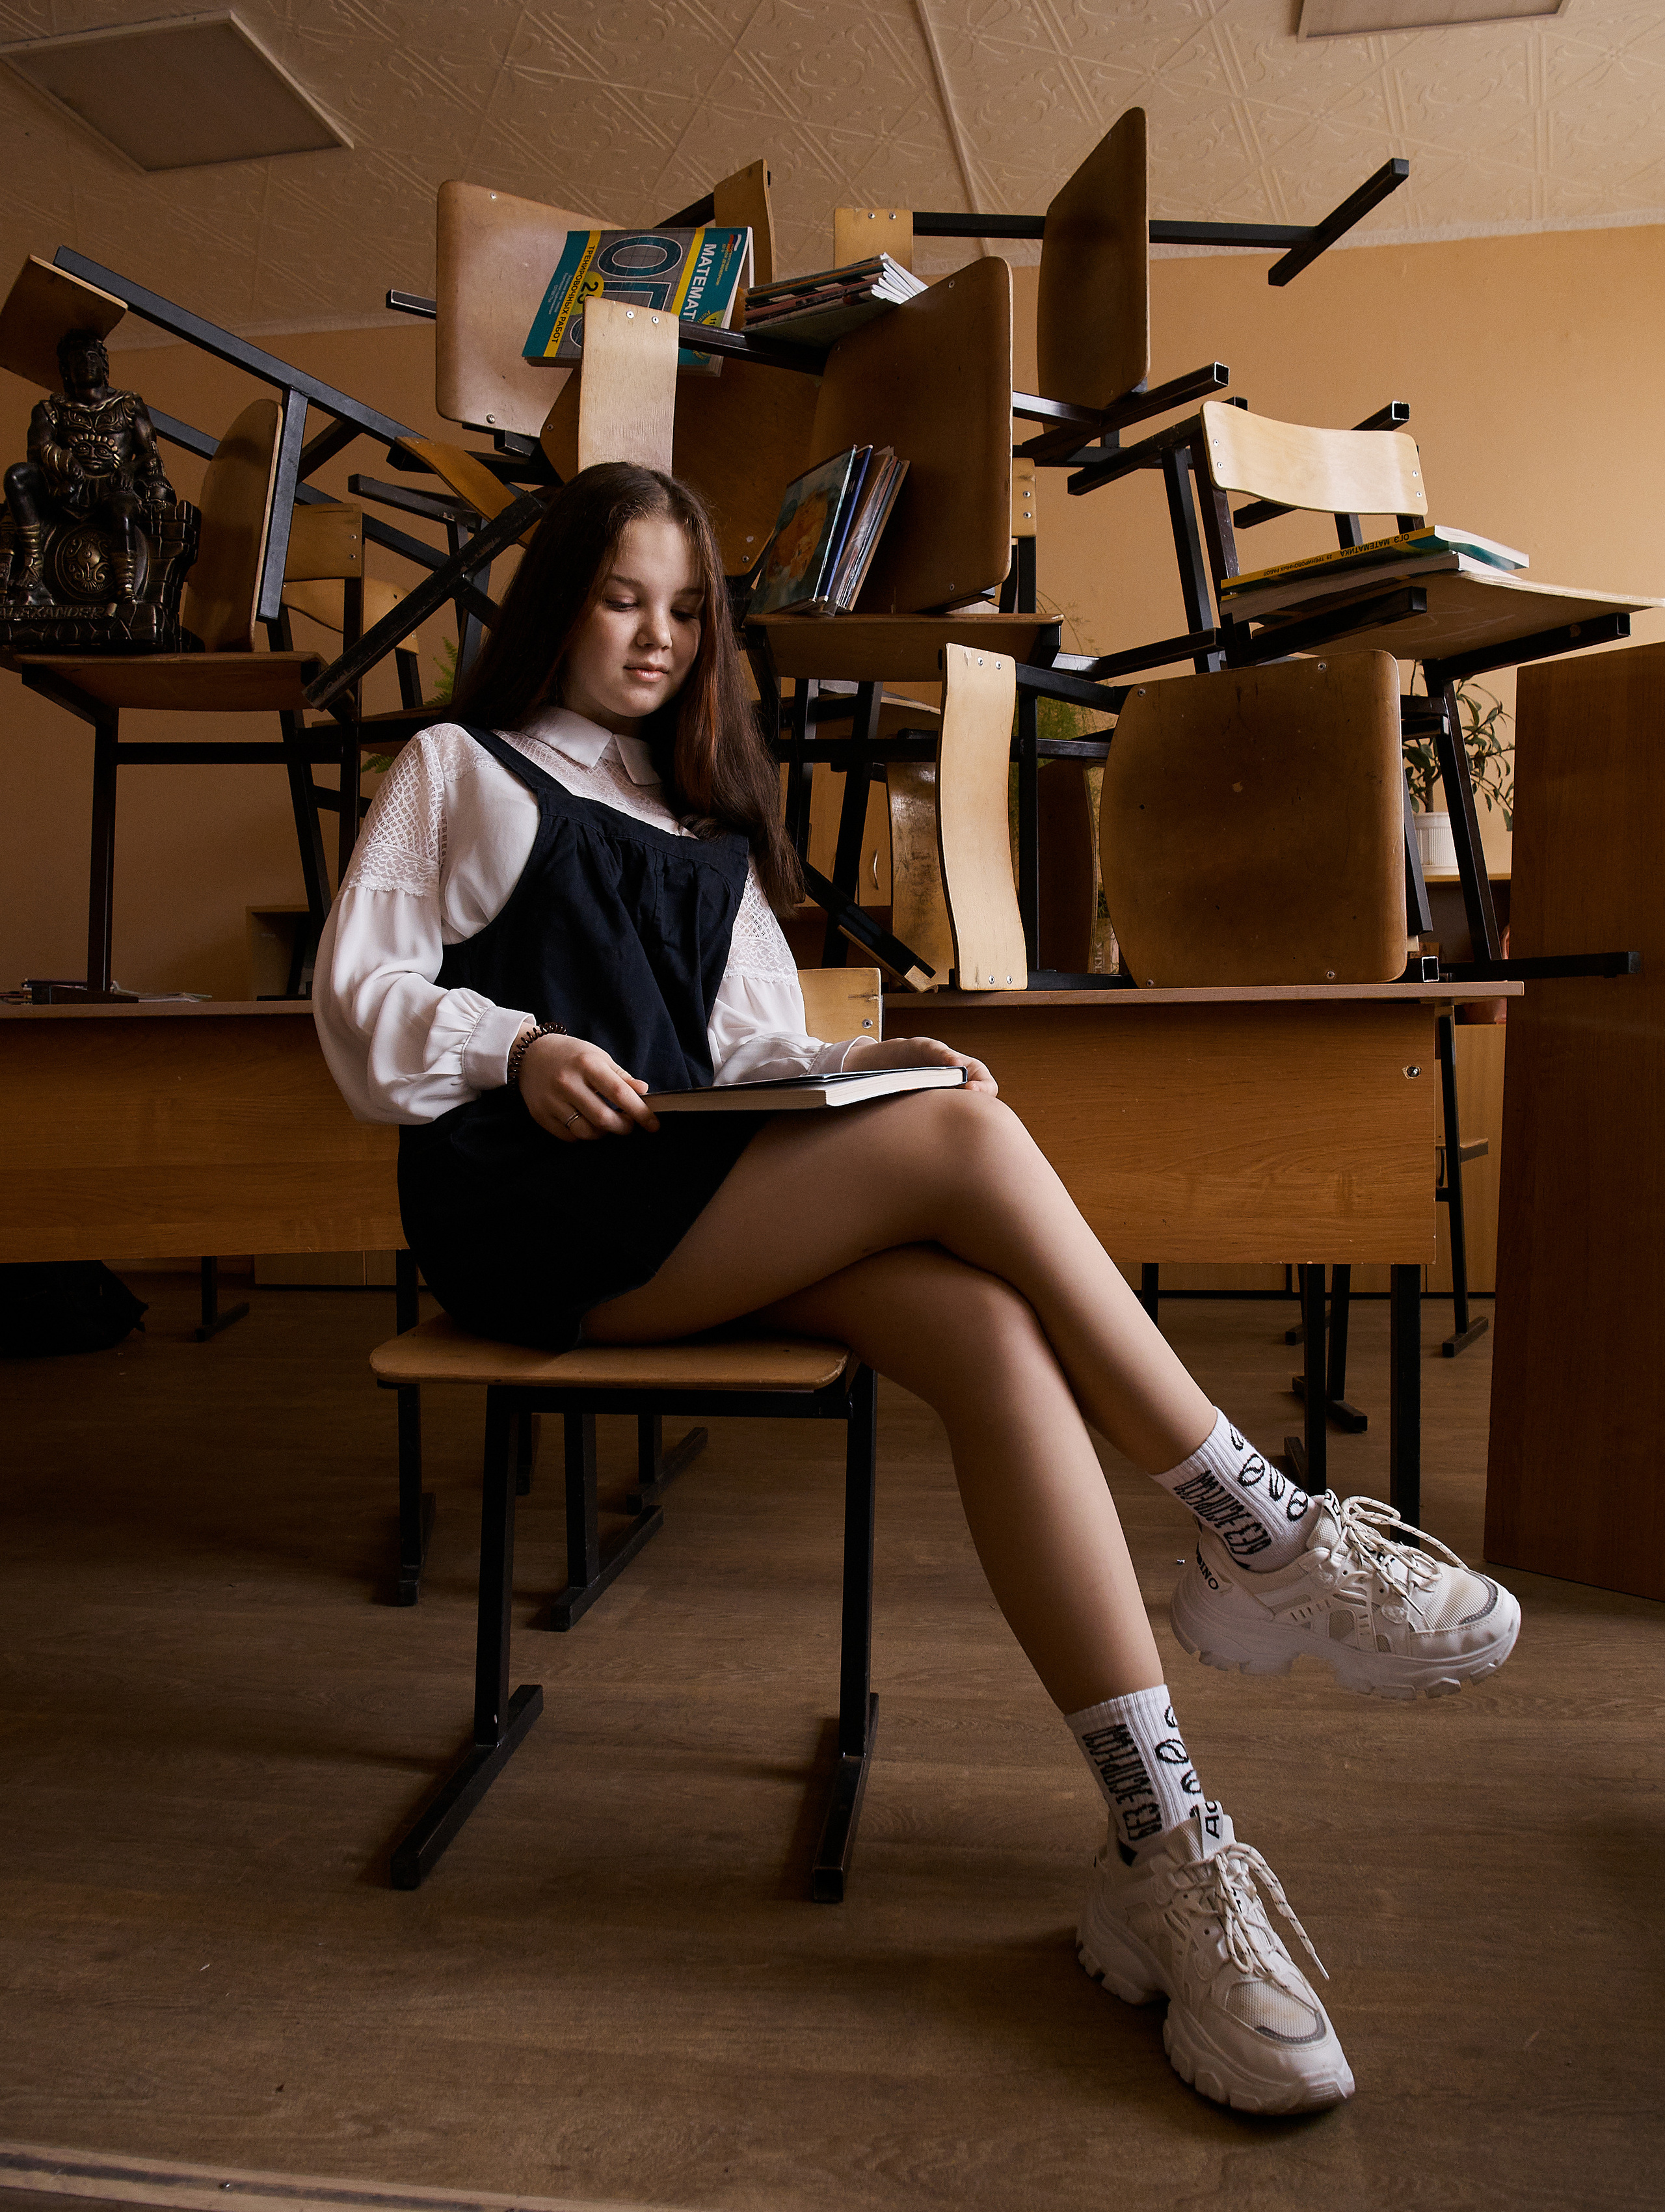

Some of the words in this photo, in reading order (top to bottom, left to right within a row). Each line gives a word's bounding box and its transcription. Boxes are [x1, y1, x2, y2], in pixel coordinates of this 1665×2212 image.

[561, 245, 595, 313] ТРЕНИРОВОЧНЫХ
[683, 243, 712, 323] МАТЕМАТ
[552, 314, 566, 343] РАБОТ
[1340, 538, 1391, 557] МАТЕМАТИКА
[1394, 533, 1409, 544] ОГЭ
[1263, 566, 1280, 577] РАБОТ
[1280, 556, 1325, 571] ТРЕНИРОВОЧНЫХ
